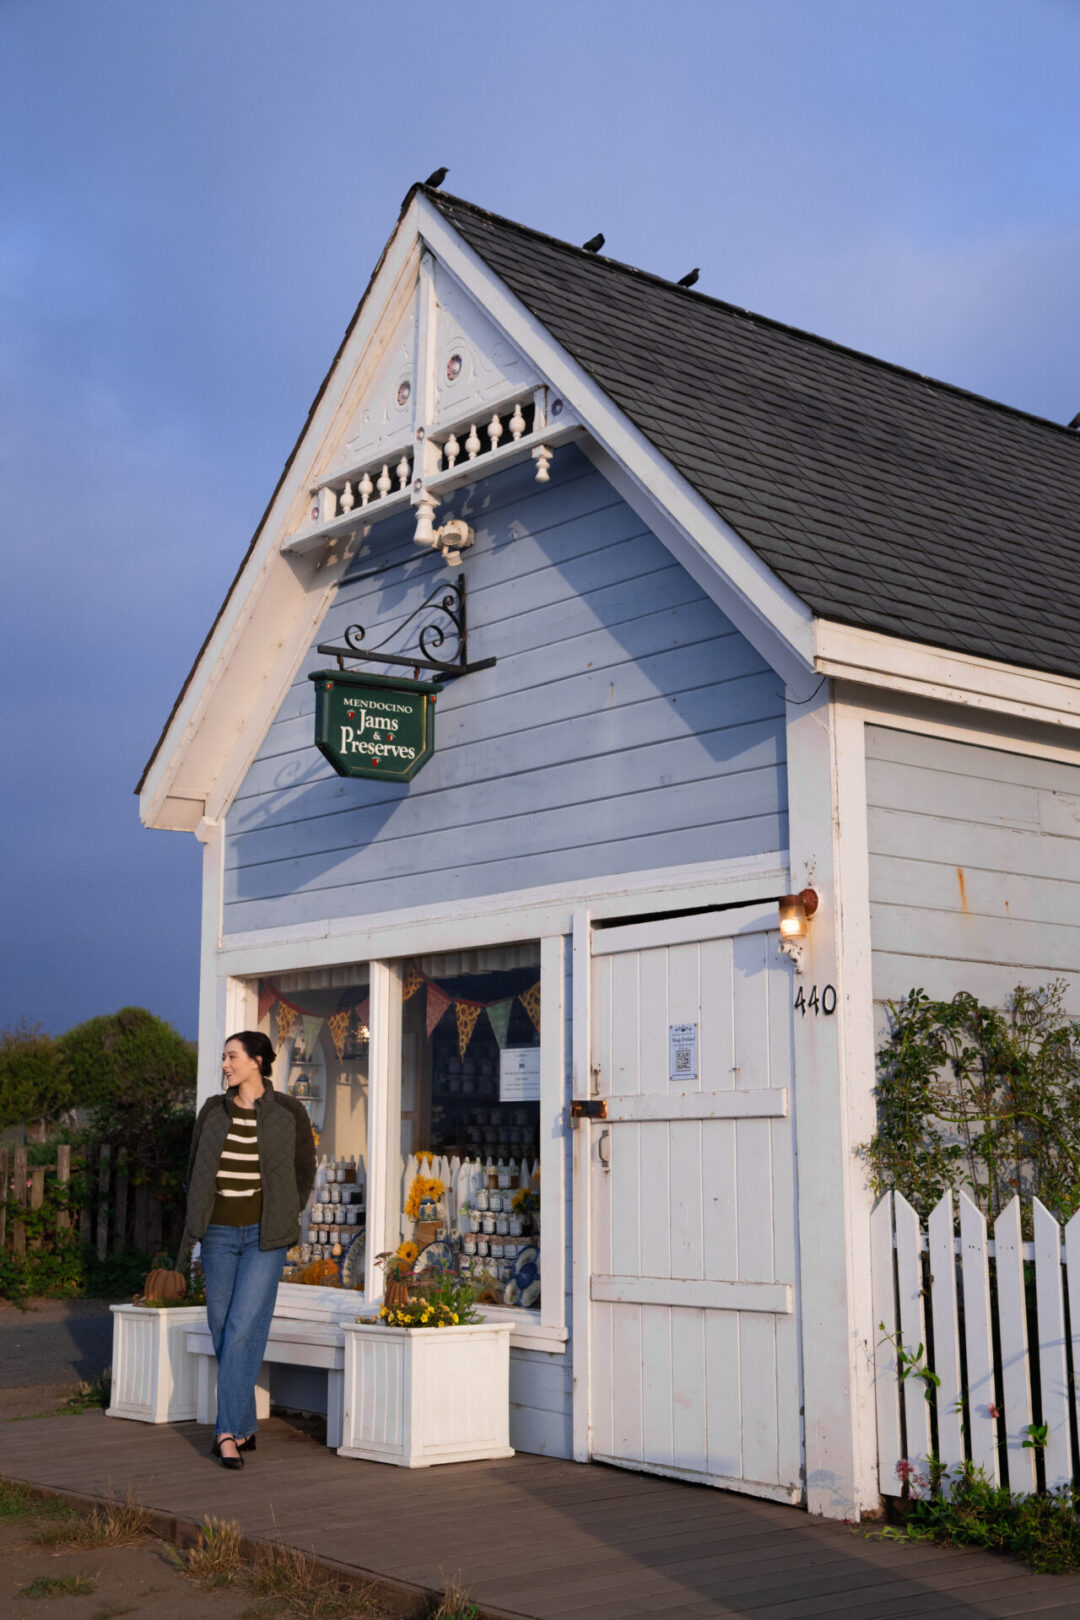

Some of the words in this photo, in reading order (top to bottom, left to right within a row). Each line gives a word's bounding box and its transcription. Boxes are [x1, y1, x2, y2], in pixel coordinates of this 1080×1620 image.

[343, 698, 413, 714] MENDOCINO
[357, 709, 399, 735] Jams
[340, 726, 415, 759] Preserves
[373, 731, 381, 740] &
[794, 984, 837, 1018] 440
